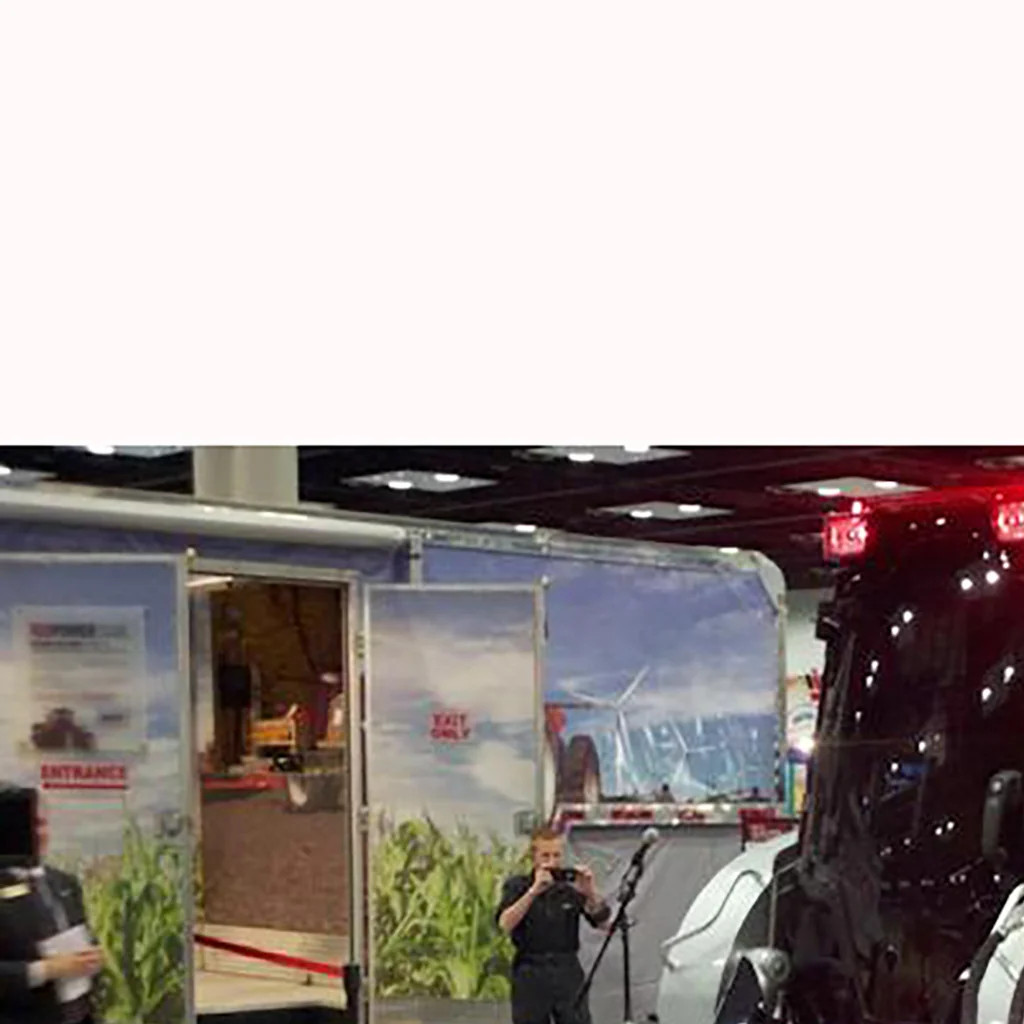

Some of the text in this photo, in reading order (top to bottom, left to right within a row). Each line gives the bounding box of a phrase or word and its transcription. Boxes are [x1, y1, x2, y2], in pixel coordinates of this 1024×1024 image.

[433, 712, 468, 727] EXIT
[430, 728, 471, 741] ONLY
[41, 763, 127, 780] ENTRANCE
